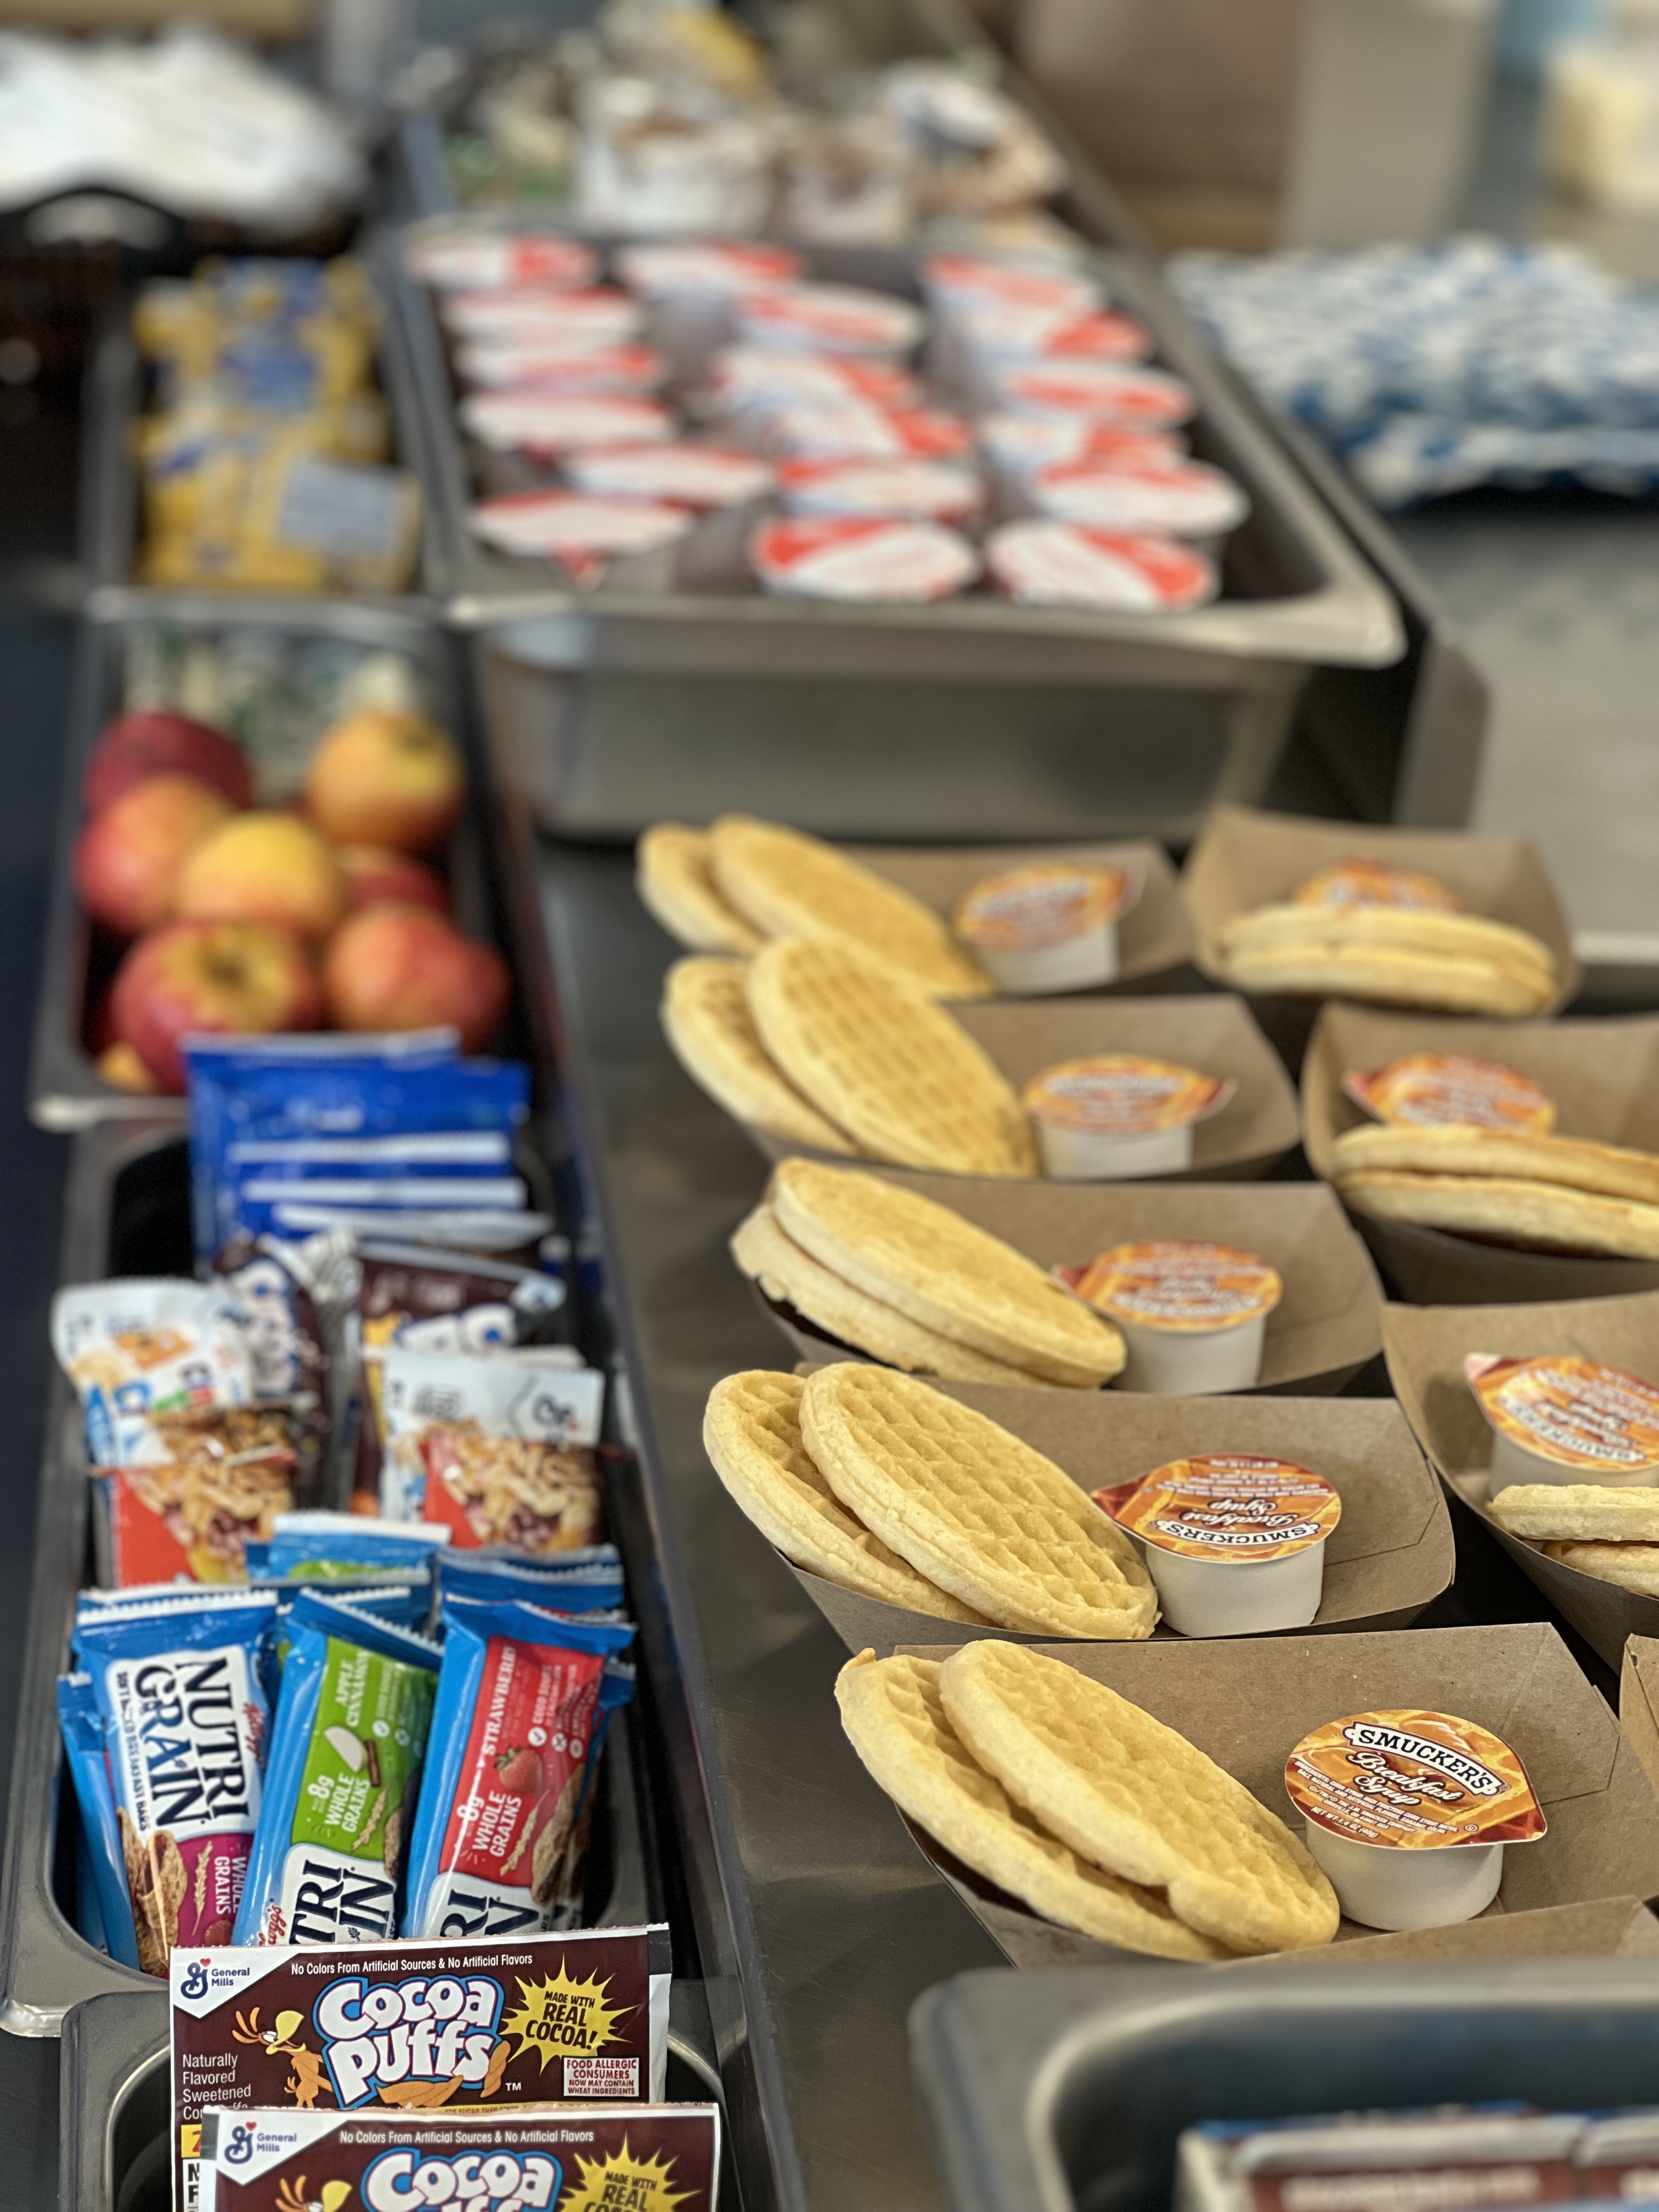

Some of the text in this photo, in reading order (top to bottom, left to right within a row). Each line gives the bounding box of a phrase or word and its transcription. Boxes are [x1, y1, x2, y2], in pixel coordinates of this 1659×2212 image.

[1182, 1511, 1298, 1527] Breakfast
[1209, 1498, 1276, 1516] Syrup
[1167, 1523, 1307, 1544] SMUCKER'S
[481, 1645, 516, 1756] STRAWBERRY
[136, 1665, 212, 1826] GRAIN
[176, 1657, 249, 1819] NUTRI
[1358, 1728, 1494, 1790] SMUCKER'S
[307, 1774, 335, 1799] 8g
[1347, 1752, 1464, 1801] Breakfast
[324, 1772, 354, 1825] WHOLE
[1353, 1775, 1421, 1805] Syrup
[136, 1801, 151, 1831] BARS
[341, 1778, 371, 1832] GRAINS
[1311, 1806, 1328, 1816] NET
[472, 1790, 506, 1850] WHOLE
[489, 1795, 522, 1857] GRAINS
[215, 1856, 231, 1915] GRAINS
[289, 1859, 344, 1945] TRI
[211, 1967, 250, 1977] General
[292, 1954, 533, 1975] No Colors From Artificial Sources & No Artificial Flavors
[211, 1978, 234, 1987] Mills
[318, 1979, 496, 2040] Cocoa
[544, 1991, 595, 2008] MADE WITH
[543, 2002, 587, 2027] REAL
[526, 2019, 598, 2050] COCOA!
[182, 2053, 238, 2069] Naturally
[567, 2059, 637, 2069] FOOD ALLERGIC
[182, 2069, 235, 2085] Flavored
[573, 2069, 630, 2079] CONSUMERS
[182, 2084, 251, 2103] Sweetened
[505, 2083, 522, 2091] TM
[256, 2143, 280, 2152] Mills
[257, 2132, 297, 2143] General
[340, 2129, 594, 2143] No Colors From Artificial Sources & No Artificial Flavors
[367, 2152, 554, 2212] Cocoa
[604, 2171, 658, 2191] MADE WITH
[601, 2184, 648, 2212] REAL
